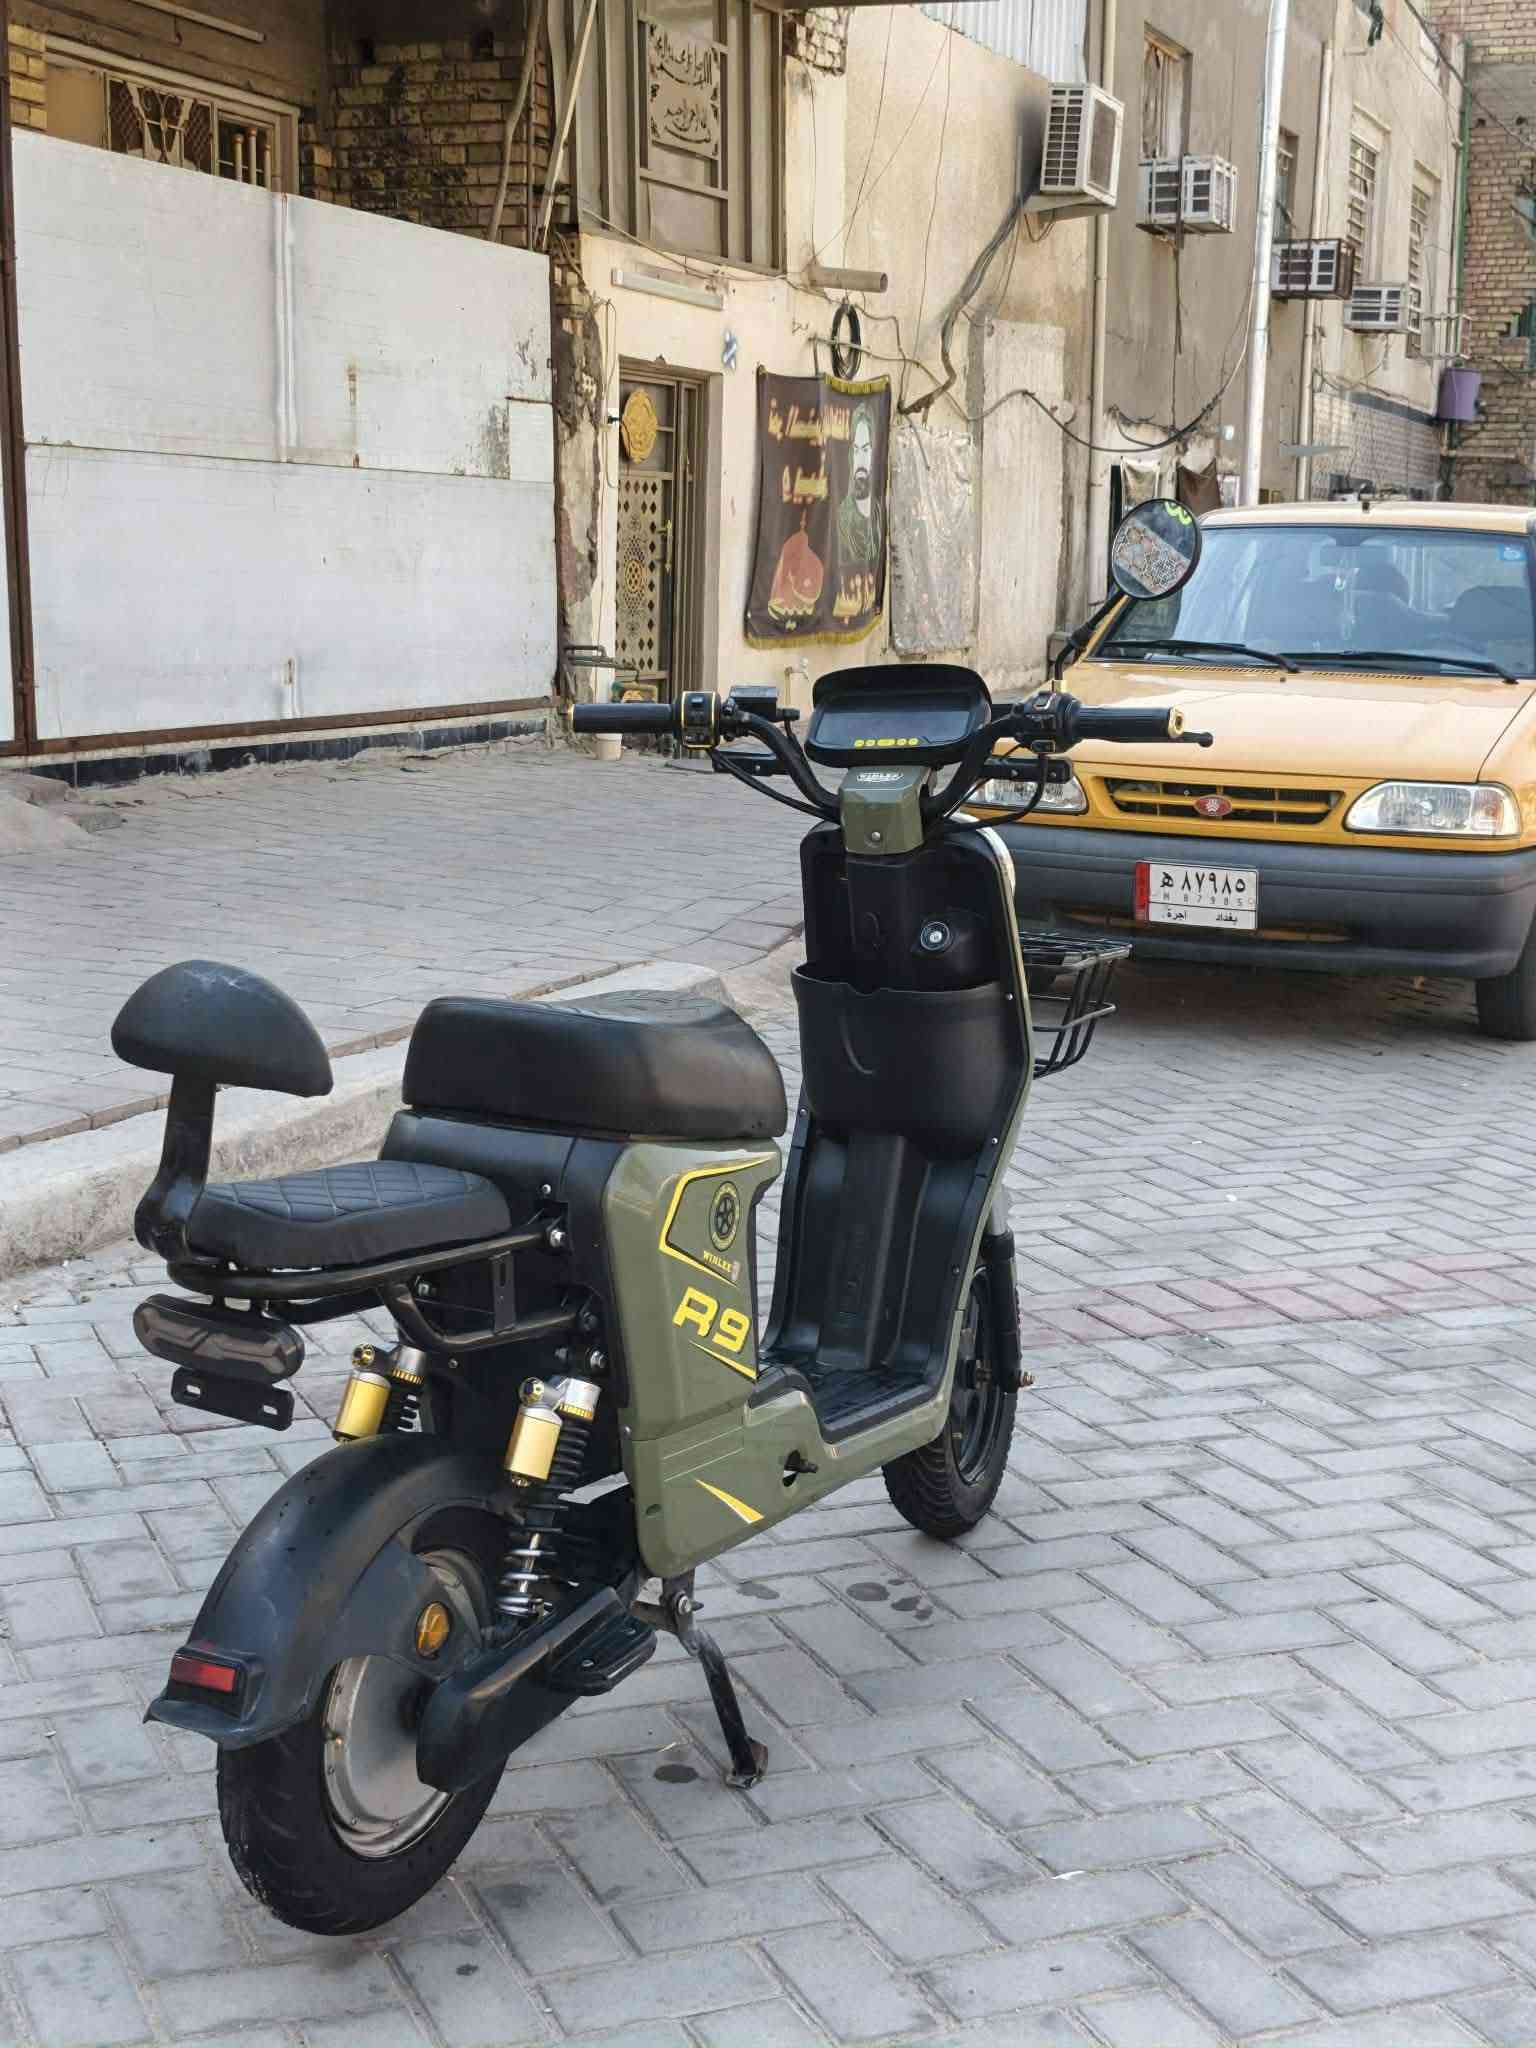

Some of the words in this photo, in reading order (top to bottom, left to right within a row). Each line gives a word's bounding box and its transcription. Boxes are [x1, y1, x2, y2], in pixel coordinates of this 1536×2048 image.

[1181, 871, 1246, 894] ٨٧٩٨٥
[1215, 911, 1238, 925] بغداد
[672, 1286, 750, 1354] R9
